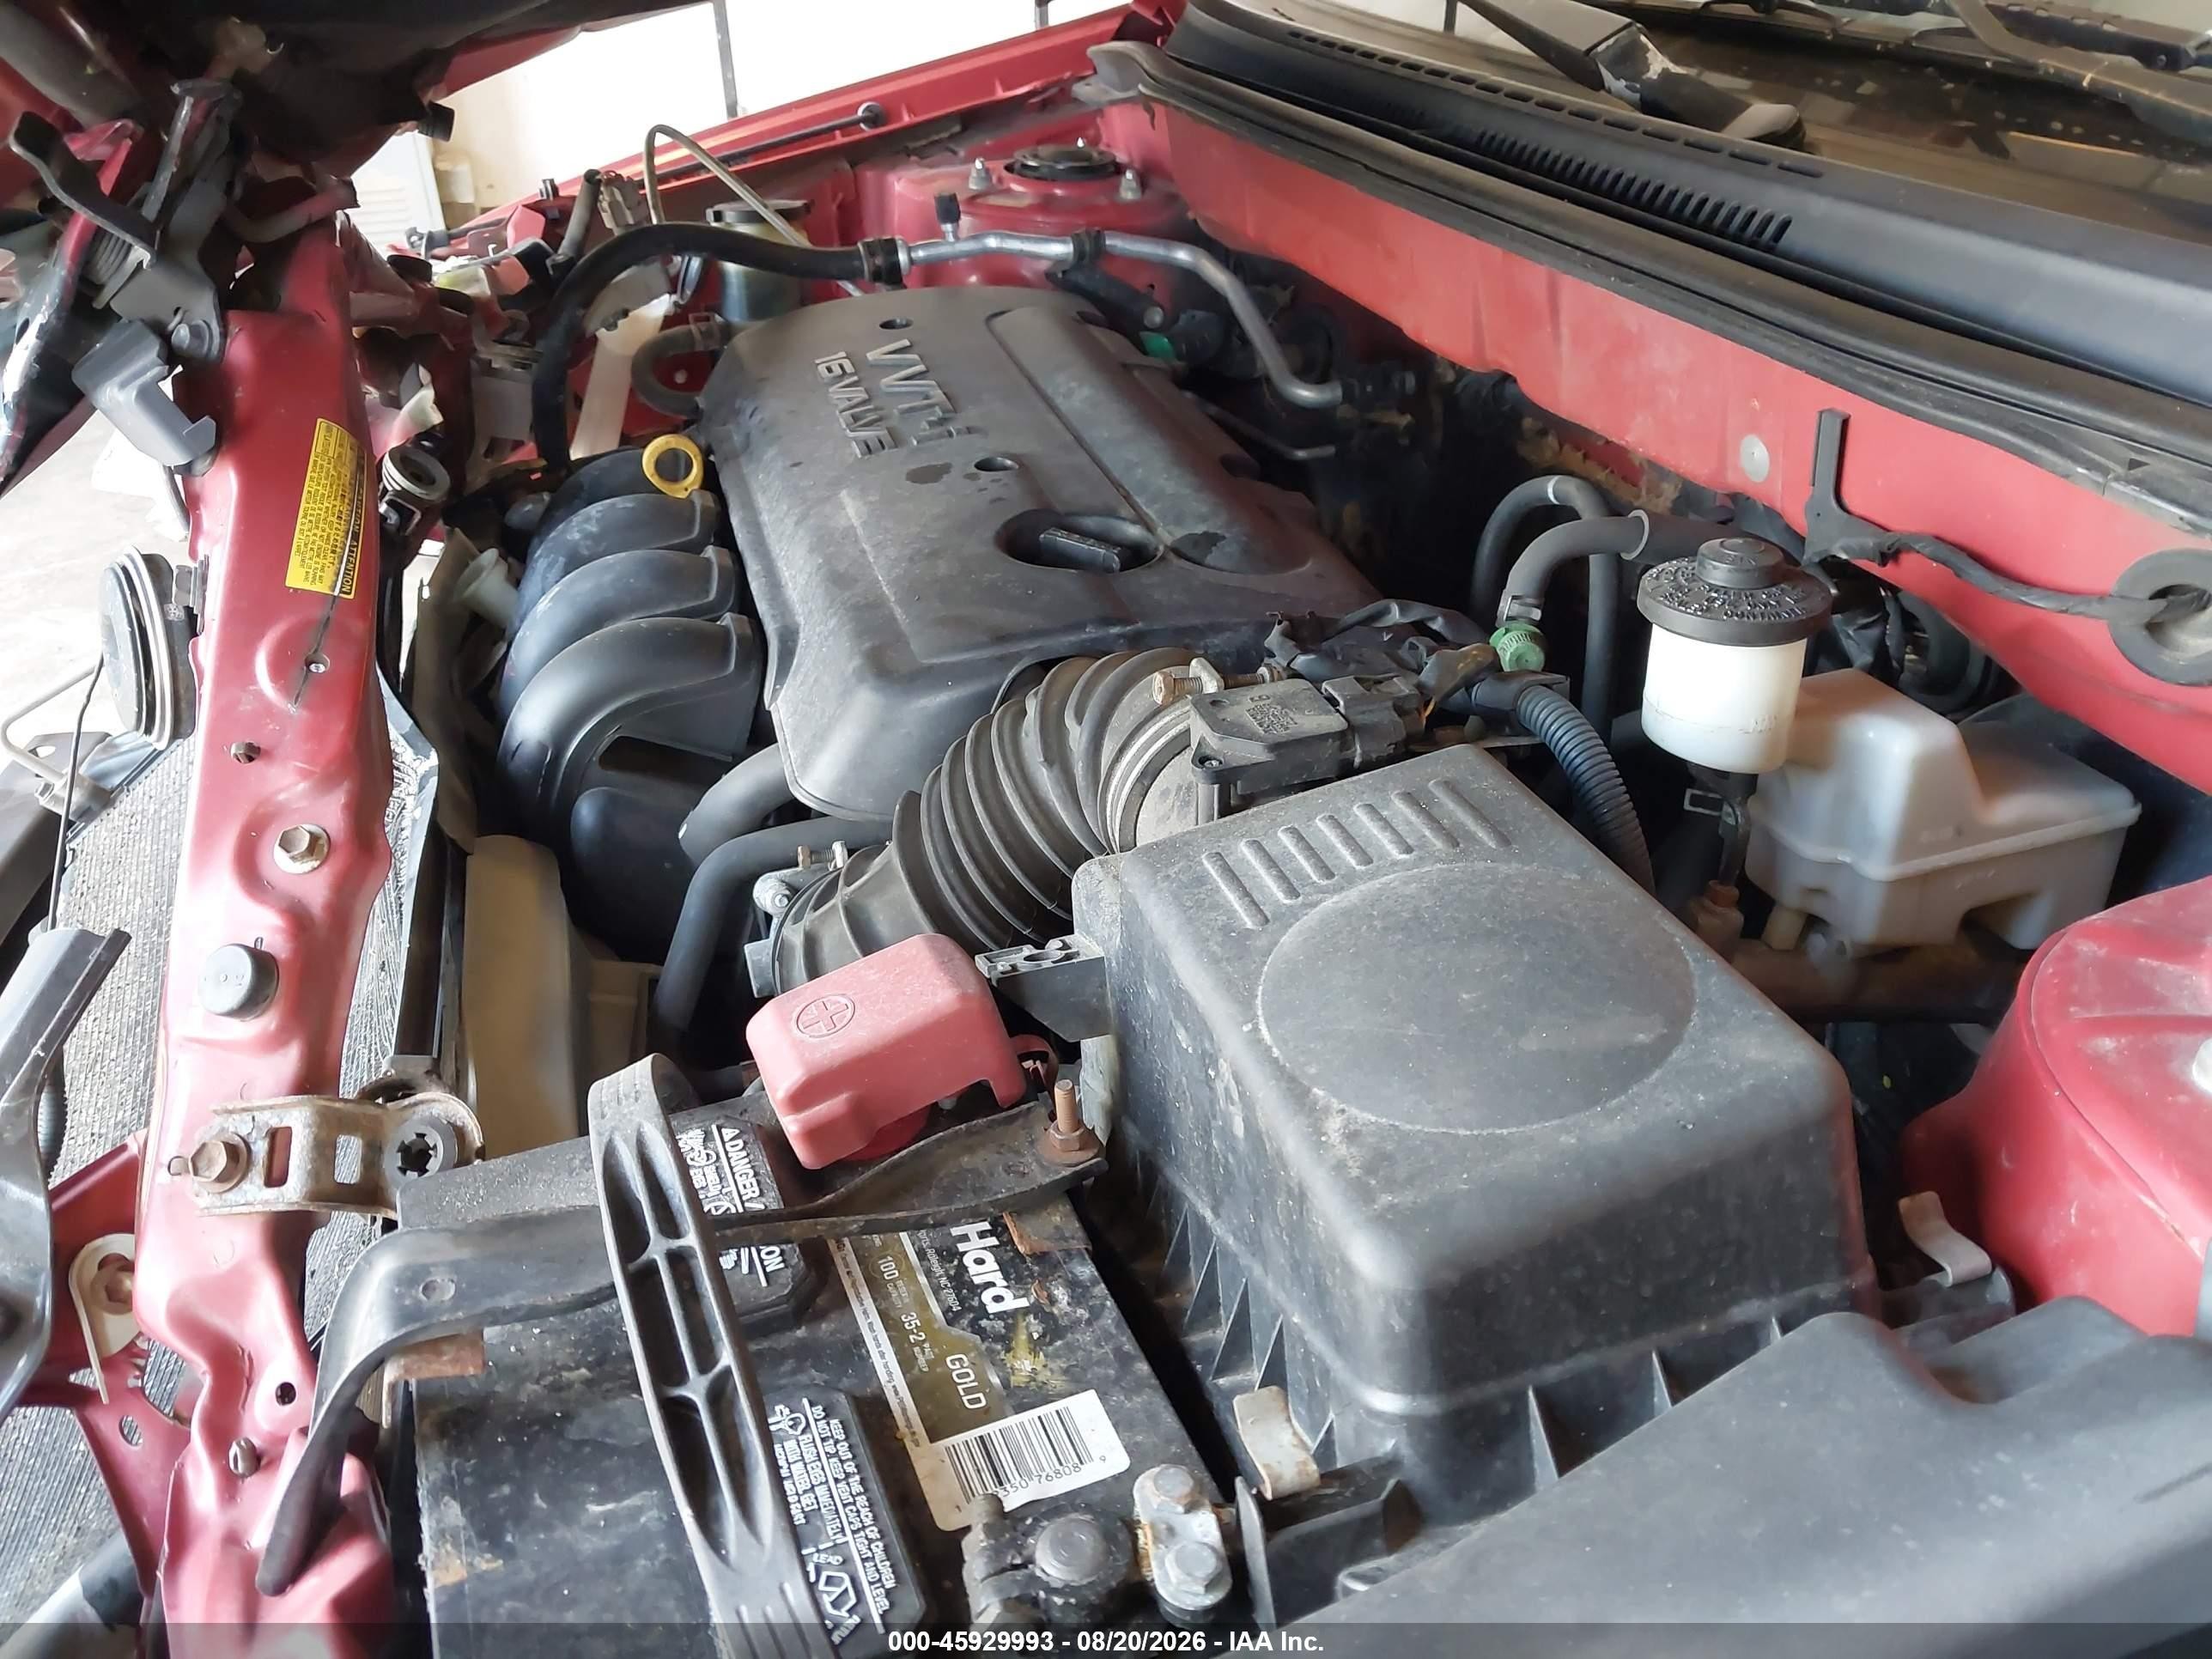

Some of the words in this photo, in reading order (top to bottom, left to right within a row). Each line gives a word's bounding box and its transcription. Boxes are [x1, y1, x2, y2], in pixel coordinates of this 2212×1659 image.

[828, 374, 897, 458] VALVE
[341, 540, 356, 592] ATTENTION
[689, 1167, 708, 1189] EYES
[877, 1255, 899, 1280] 100
[949, 1221, 1030, 1316] Hard
[938, 1275, 951, 1288] NC
[899, 1310, 926, 1344] 35-2
[943, 1353, 988, 1411] GOLD
[810, 1404, 826, 1419] DO
[815, 1419, 832, 1438] NOT
[828, 1417, 846, 1440] KEEP
[797, 1434, 819, 1462] FLUSH
[835, 1440, 853, 1461] OUT
[782, 1437, 803, 1462] WITH
[799, 1492, 817, 1512] GET
[805, 1460, 827, 1486] EYES
[827, 1455, 846, 1480] KEEP
[842, 1460, 858, 1474] OF
[1034, 1461, 1082, 1486] 76808
[1098, 1454, 1107, 1463] 9
[836, 1480, 854, 1504] VENT
[847, 1474, 865, 1495] THE
[814, 1483, 844, 1540] IMMEDIATELY
[843, 1504, 863, 1530] CAPS
[854, 1493, 876, 1526] REACH
[853, 1530, 872, 1559] TIGHT
[865, 1524, 881, 1540] OF
[863, 1560, 879, 1582] AND
[870, 1540, 896, 1589] CHILDREN
